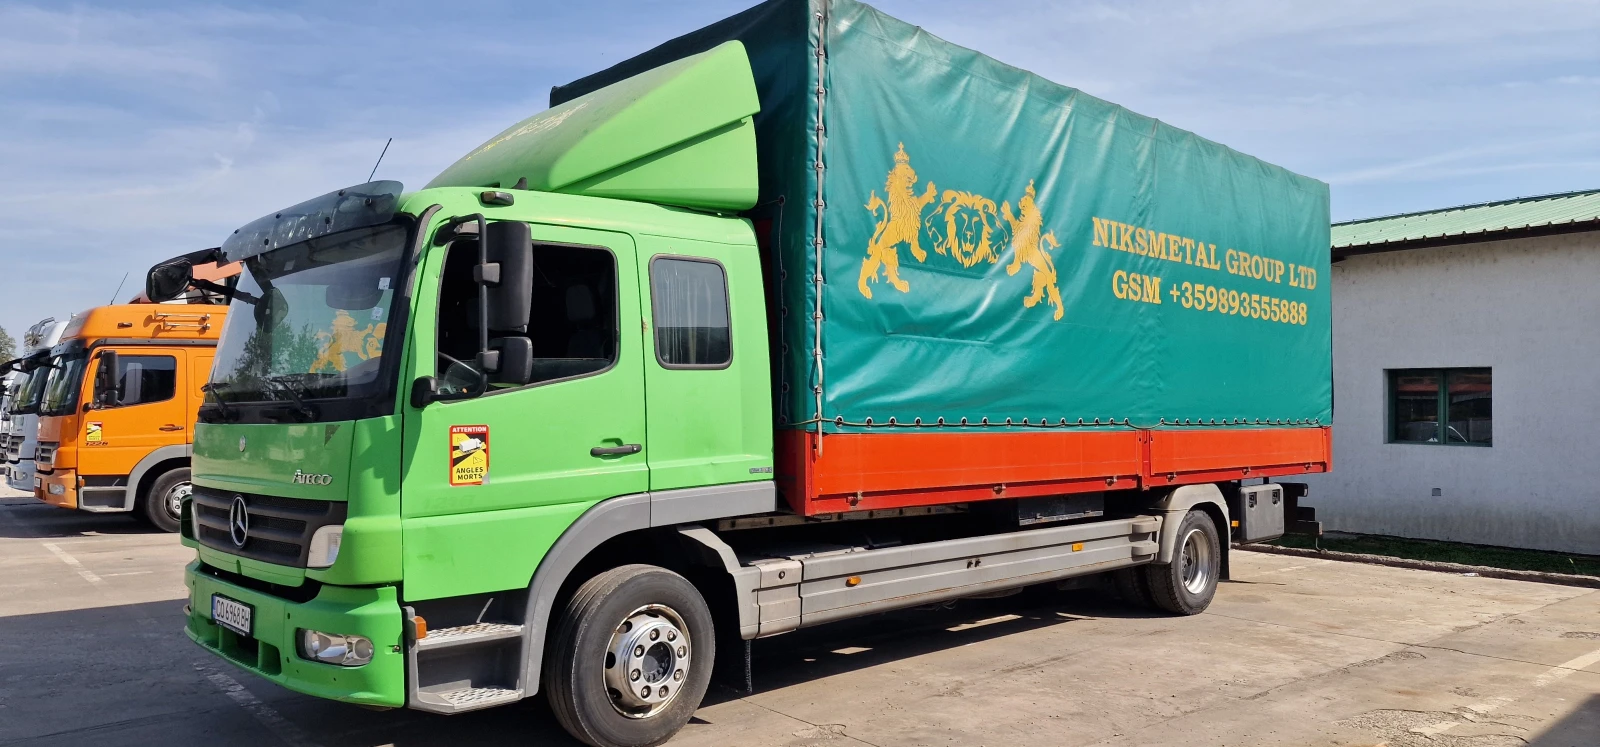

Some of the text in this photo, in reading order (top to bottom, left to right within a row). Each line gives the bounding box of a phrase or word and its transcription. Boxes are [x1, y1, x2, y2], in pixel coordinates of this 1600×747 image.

[1092, 216, 1317, 290] NIKSMETAL GROUP LTD
[1112, 269, 1308, 325] GSM +359893555888
[457, 473, 483, 481] MORTS
